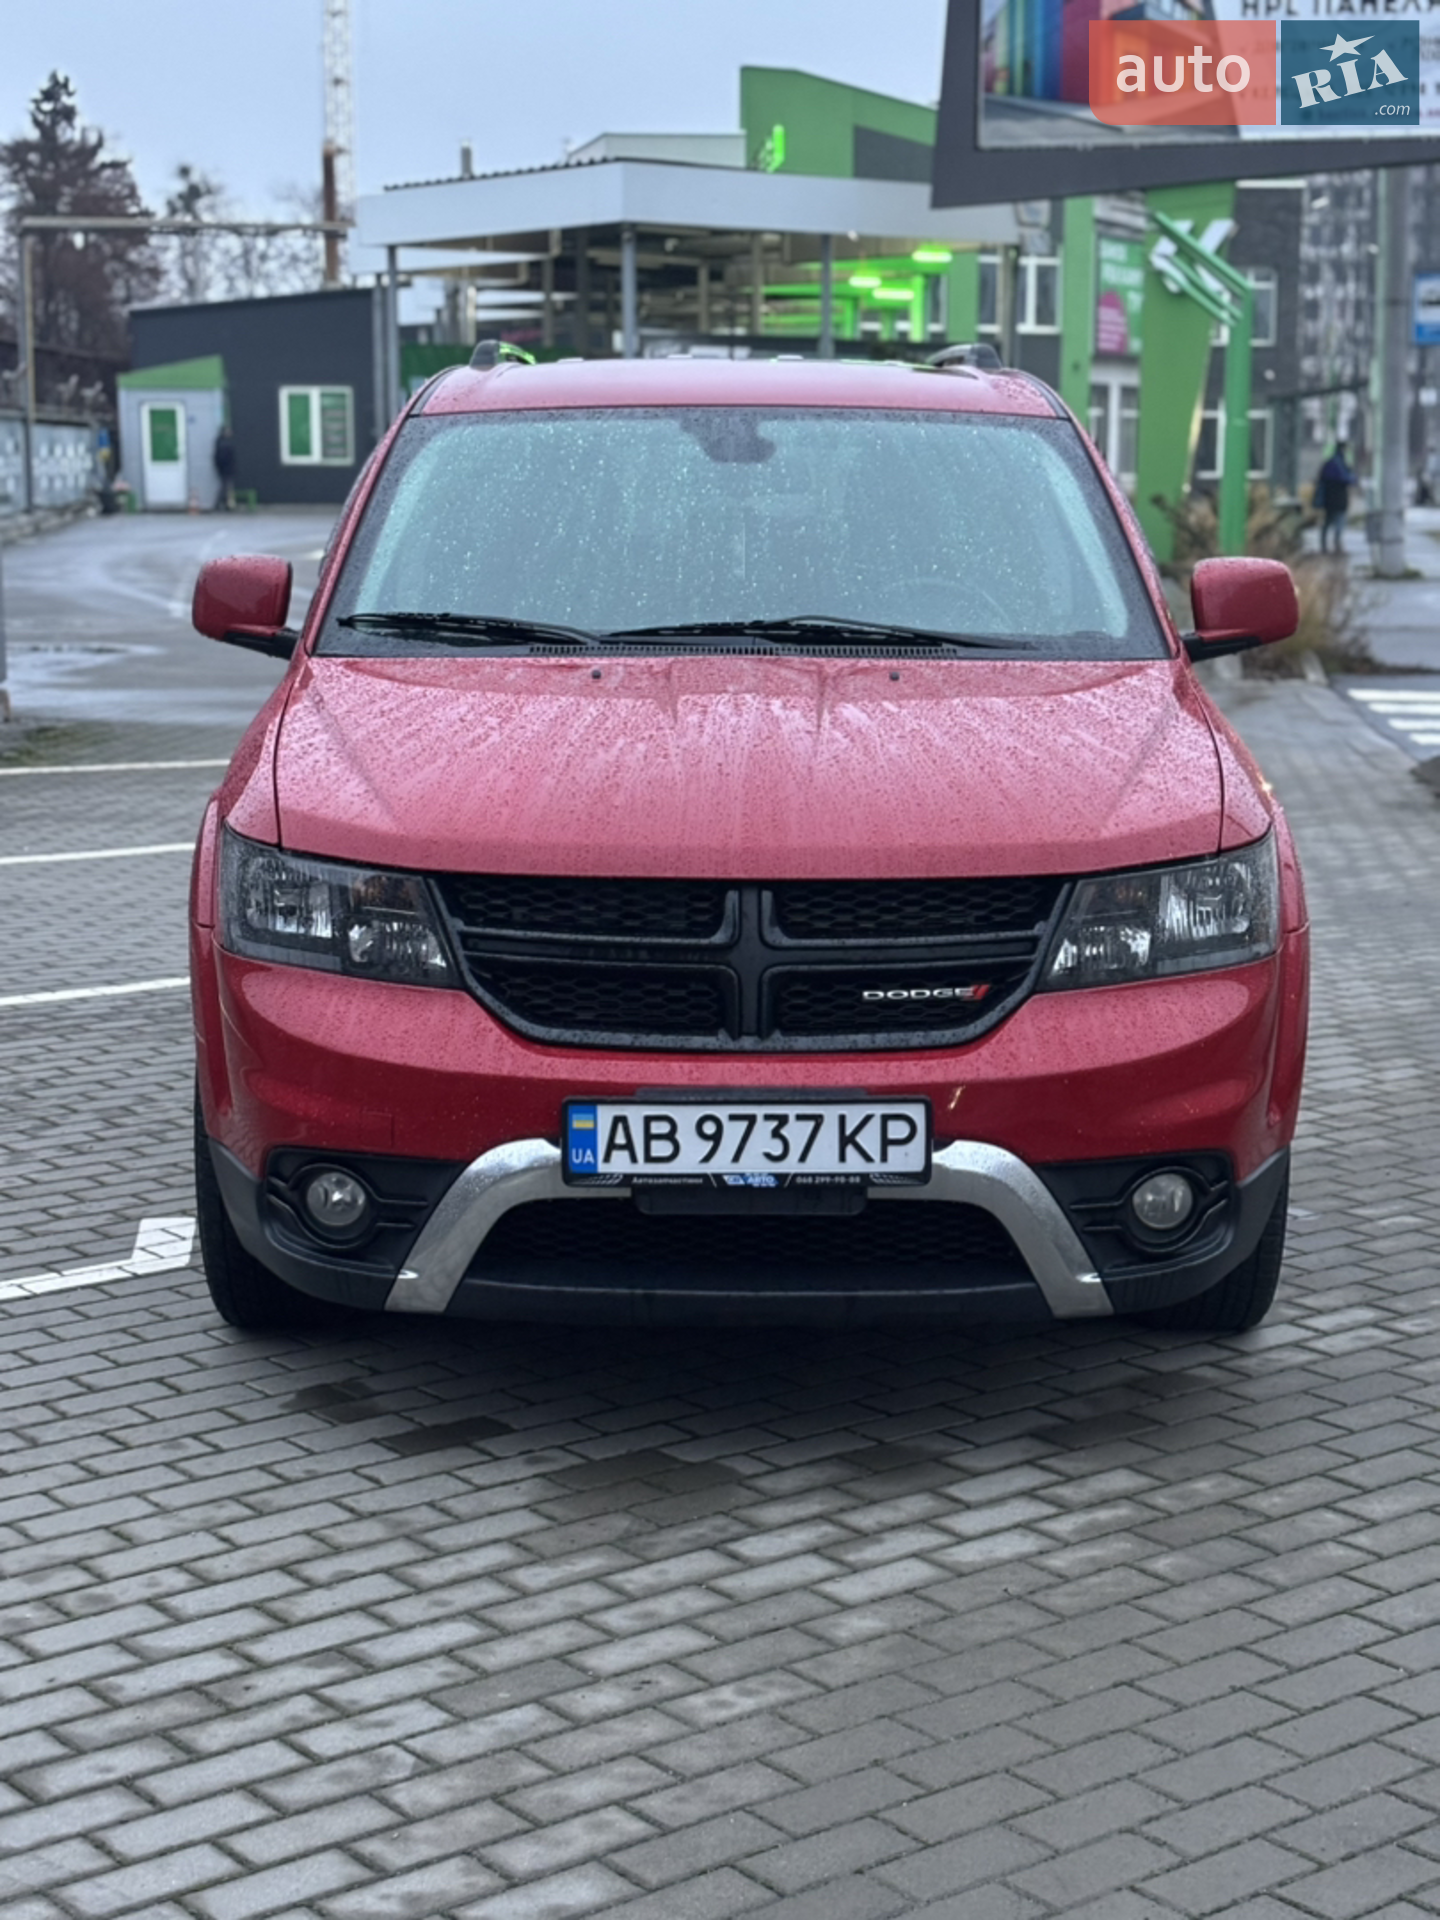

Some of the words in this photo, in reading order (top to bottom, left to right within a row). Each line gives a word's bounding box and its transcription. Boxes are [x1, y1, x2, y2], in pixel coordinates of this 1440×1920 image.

[862, 986, 975, 1000] DODGE
[602, 1114, 682, 1164] AB
[694, 1113, 825, 1164] 9737
[838, 1113, 918, 1164] KP
[571, 1147, 595, 1164] UA
